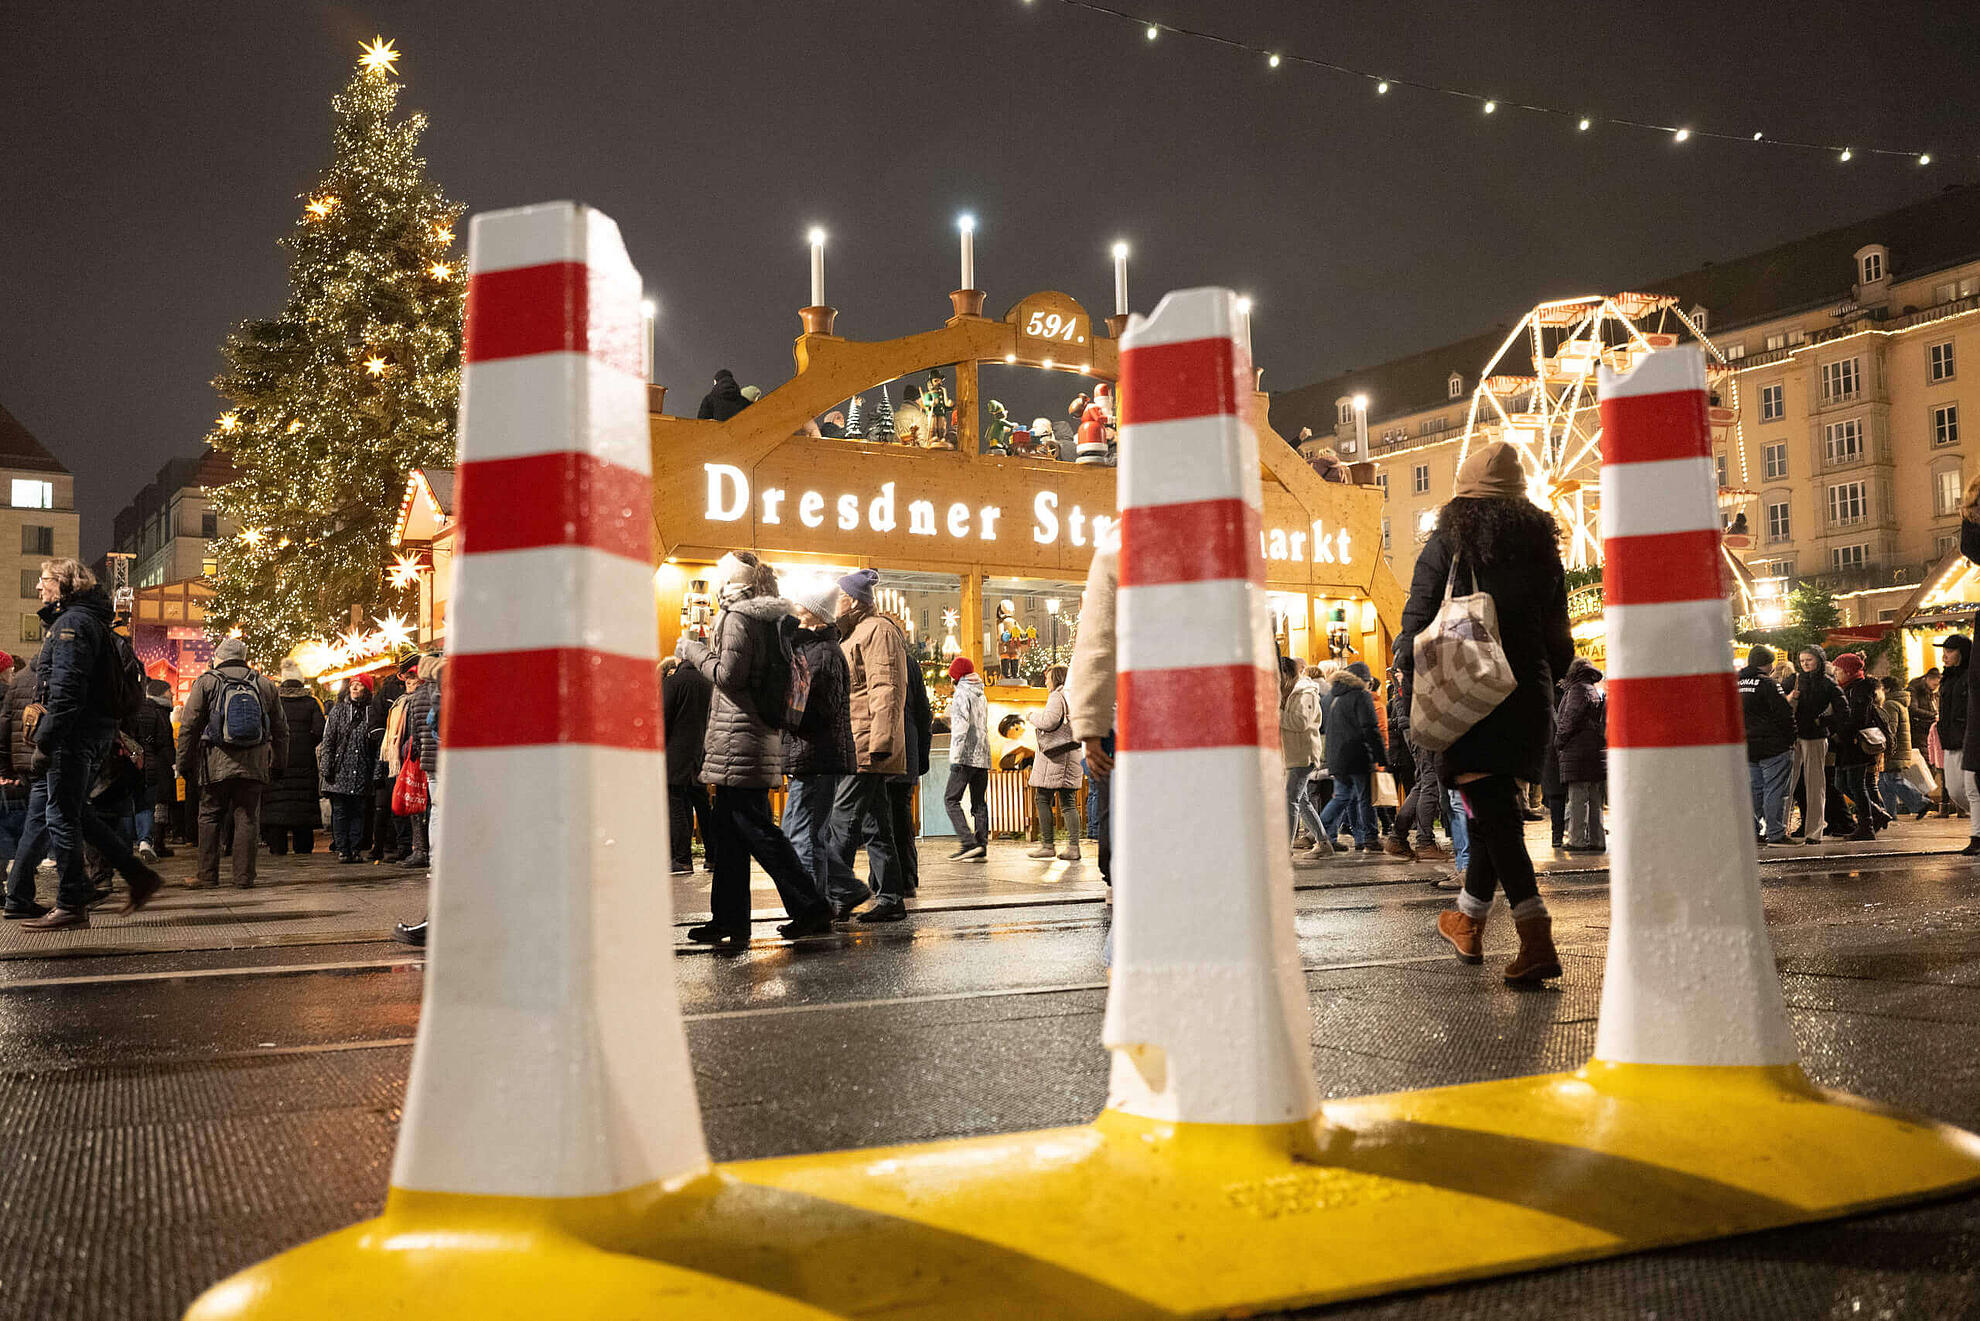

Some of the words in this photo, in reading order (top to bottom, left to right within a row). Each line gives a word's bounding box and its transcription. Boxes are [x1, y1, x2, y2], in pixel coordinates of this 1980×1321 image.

[1026, 311, 1085, 343] 591.
[704, 462, 1001, 541] Dresdner
[1580, 644, 1606, 657] WAF
